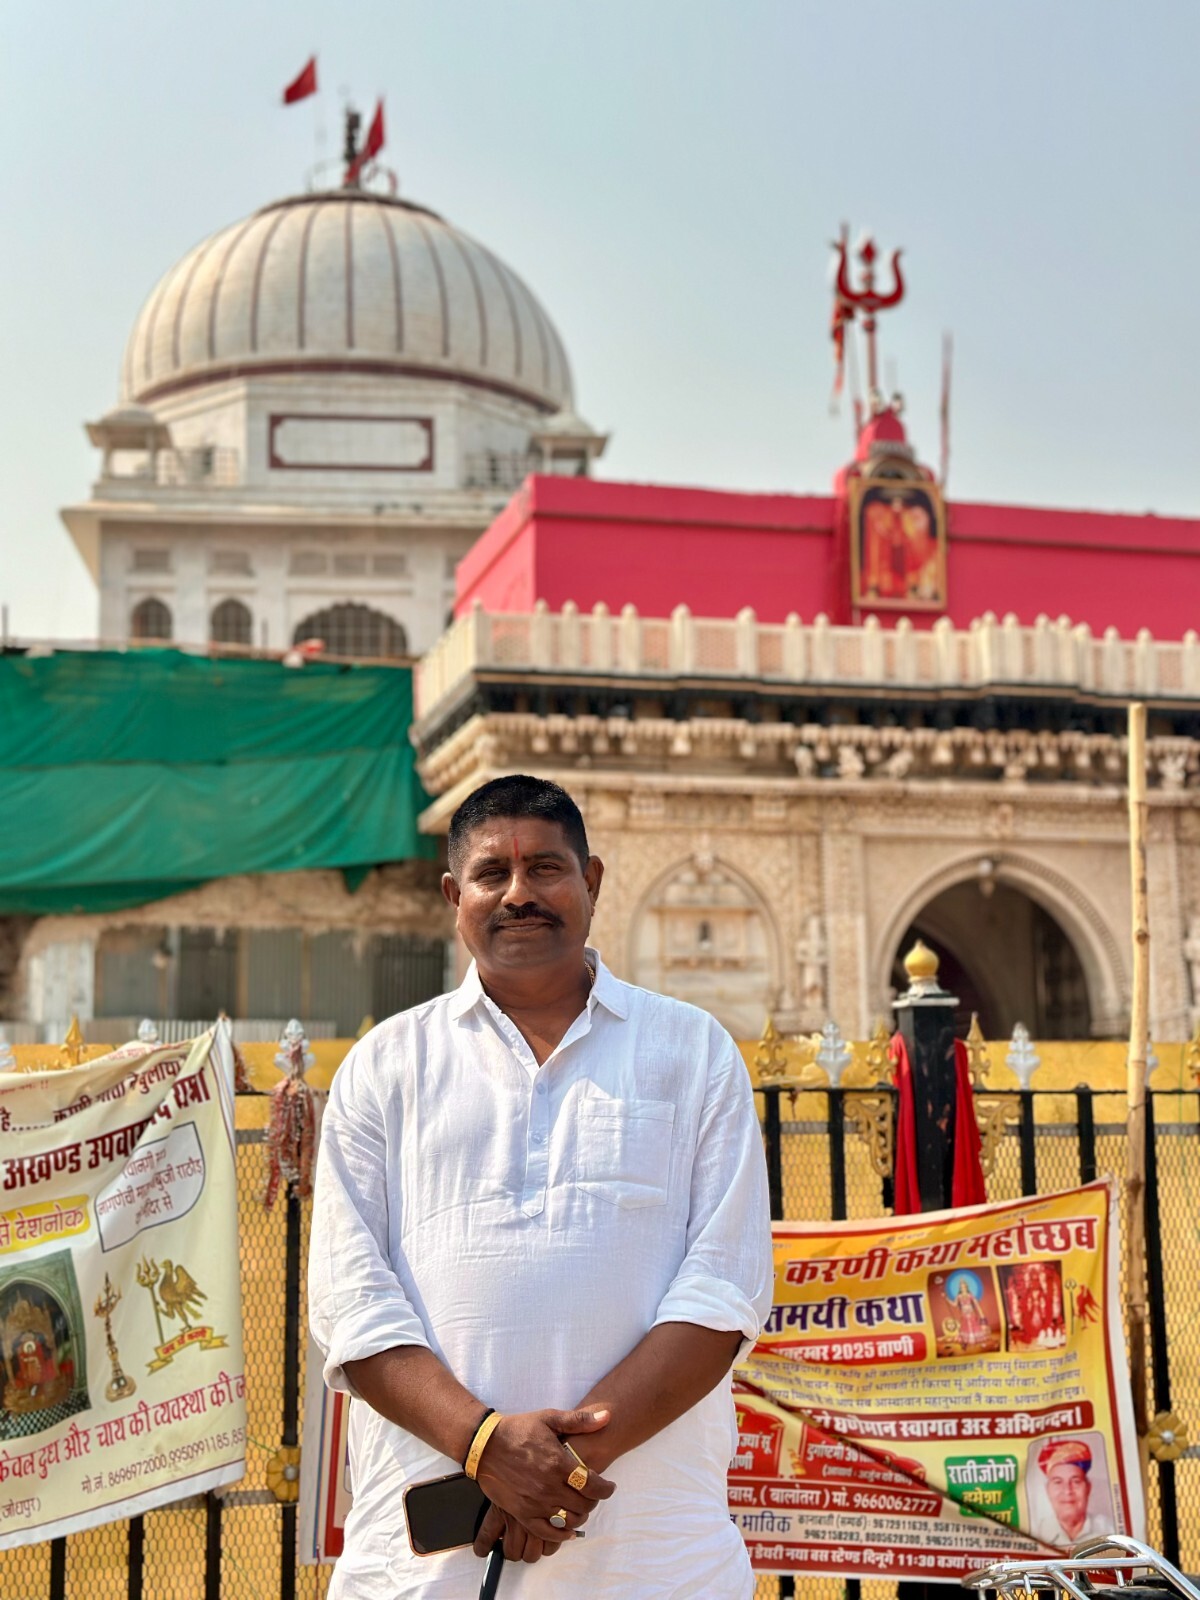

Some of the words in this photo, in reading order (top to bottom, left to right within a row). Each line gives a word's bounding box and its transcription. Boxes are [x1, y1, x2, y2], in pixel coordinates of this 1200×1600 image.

[2, 1141, 83, 1190] अखण्ड
[15, 1203, 84, 1241] देशनोक
[786, 1246, 893, 1285] करणी
[894, 1240, 967, 1274] कथा
[854, 1293, 925, 1327] कथा
[831, 1342, 875, 1361] 2025
[876, 1335, 915, 1358] ताणी
[62, 1421, 93, 1461] और
[94, 1416, 127, 1447] चाय
[127, 1400, 152, 1437] की
[152, 1387, 207, 1427] व्यवस्था
[207, 1371, 233, 1407] की
[899, 1418, 959, 1437] स्वागत
[961, 1417, 992, 1436] अर
[947, 1458, 1017, 1485] रातीजोगो
[853, 1492, 937, 1513] 9660062777
[742, 1510, 793, 1534] भाविक
[785, 1547, 808, 1562] नया
[810, 1549, 829, 1563] बस
[897, 1554, 935, 1569] 11:30
